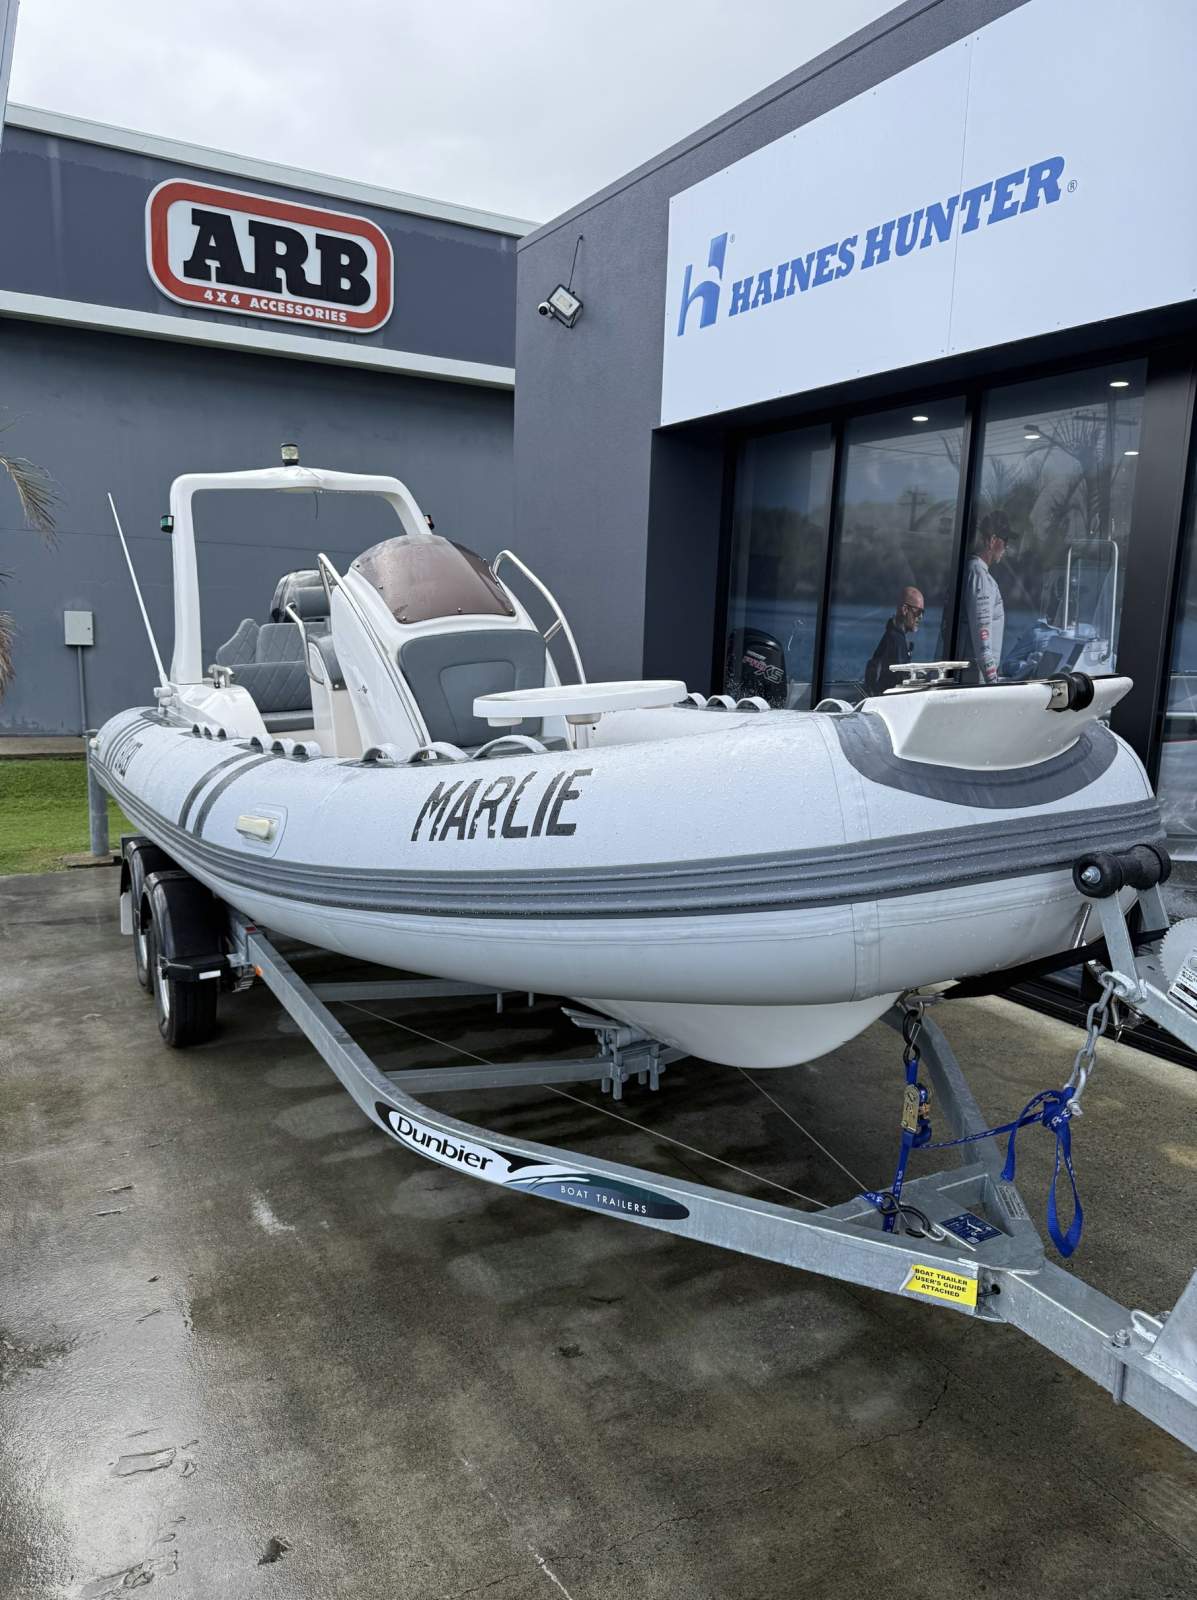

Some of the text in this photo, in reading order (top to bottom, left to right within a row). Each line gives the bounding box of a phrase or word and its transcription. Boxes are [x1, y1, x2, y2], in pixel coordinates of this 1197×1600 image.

[728, 156, 1066, 317] HAINES HUNTER
[183, 207, 372, 307] ARB
[249, 297, 348, 323] ACCESSORIES
[410, 768, 594, 842] MARLIE
[396, 1116, 494, 1171] Dunbier
[560, 1185, 648, 1214] BOAT TRAILERS
[914, 1268, 968, 1286] BOAT TRAILER
[915, 1275, 967, 1293] USER'S GUIDE
[920, 1283, 960, 1298] ATTACHED
